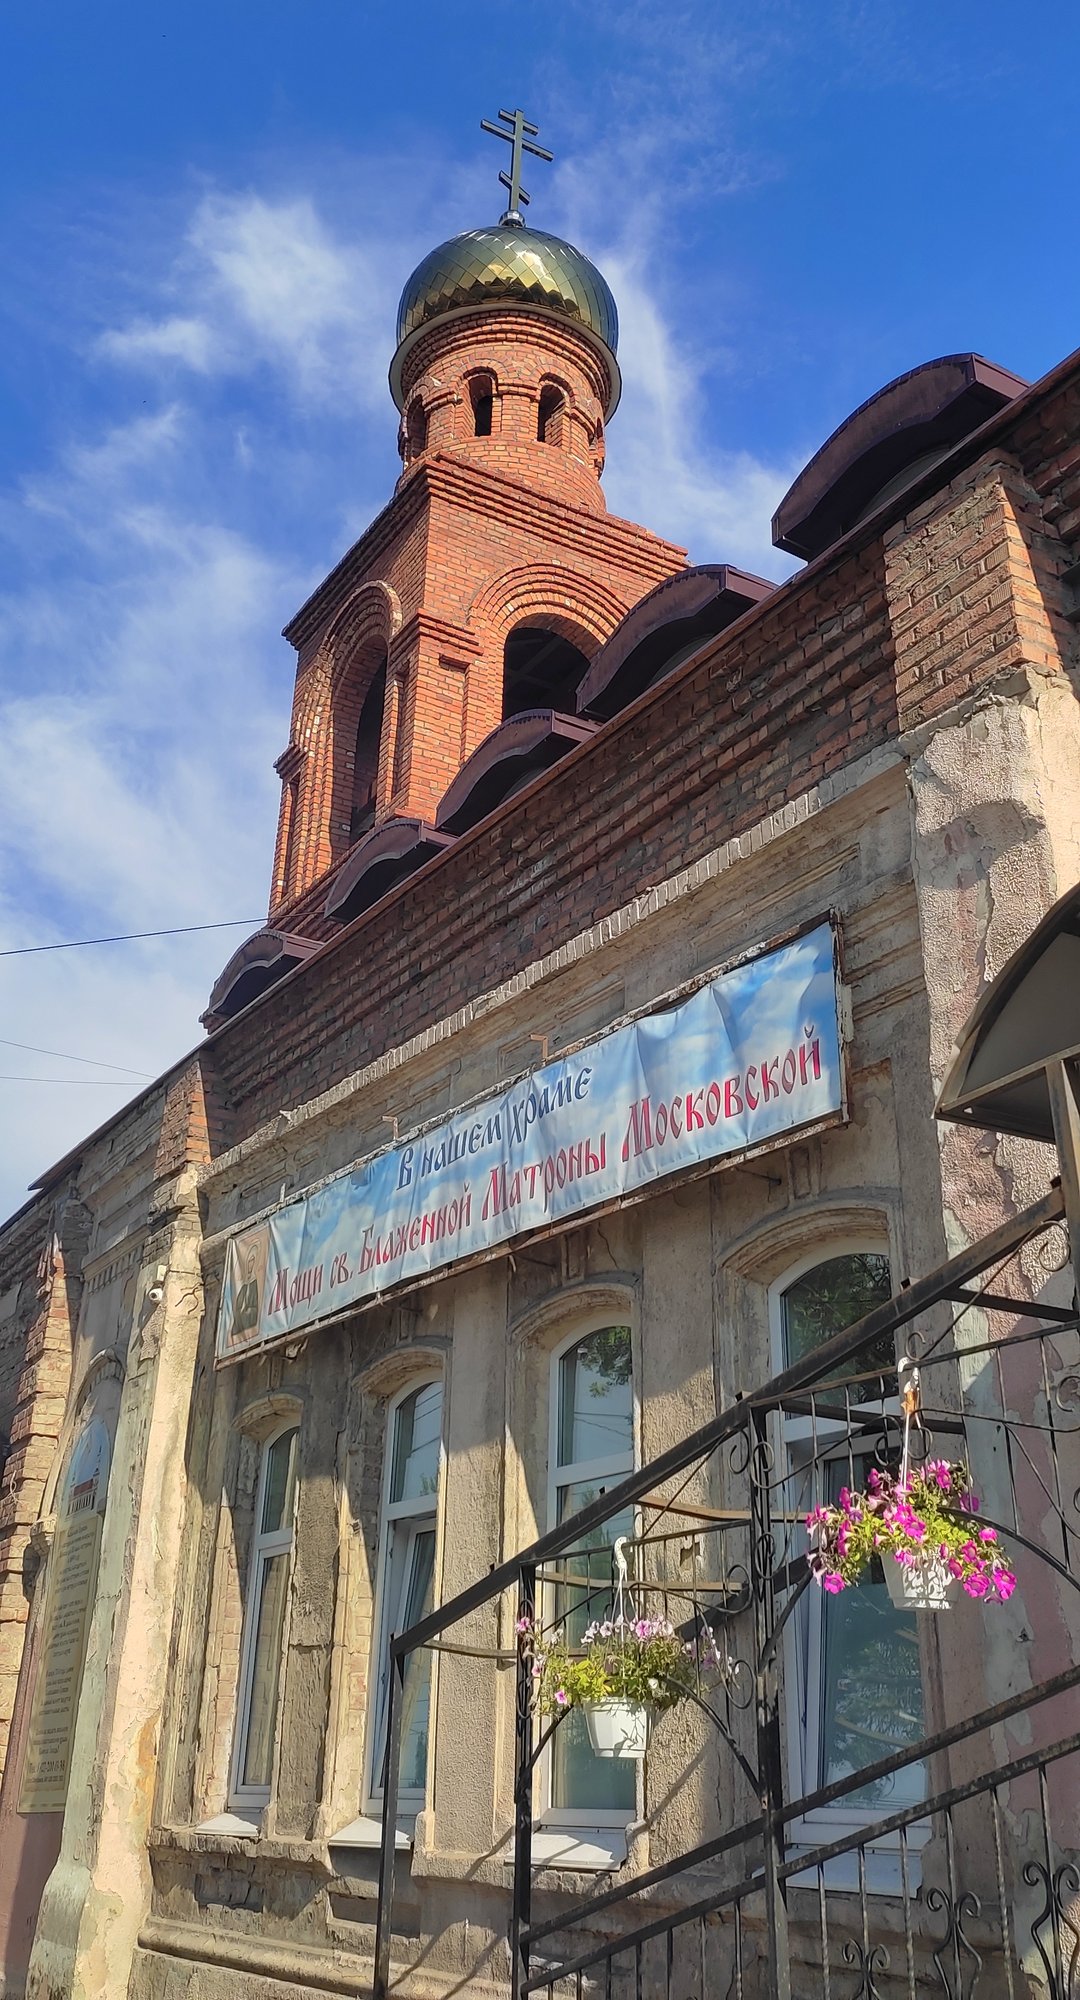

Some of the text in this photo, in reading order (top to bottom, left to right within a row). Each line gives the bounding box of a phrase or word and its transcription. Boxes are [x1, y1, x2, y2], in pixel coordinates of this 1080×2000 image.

[267, 1025, 822, 1317] Мощи св. Блаженной Матроны Московской
[421, 1113, 503, 1178] нашем
[508, 1067, 593, 1148] храме
